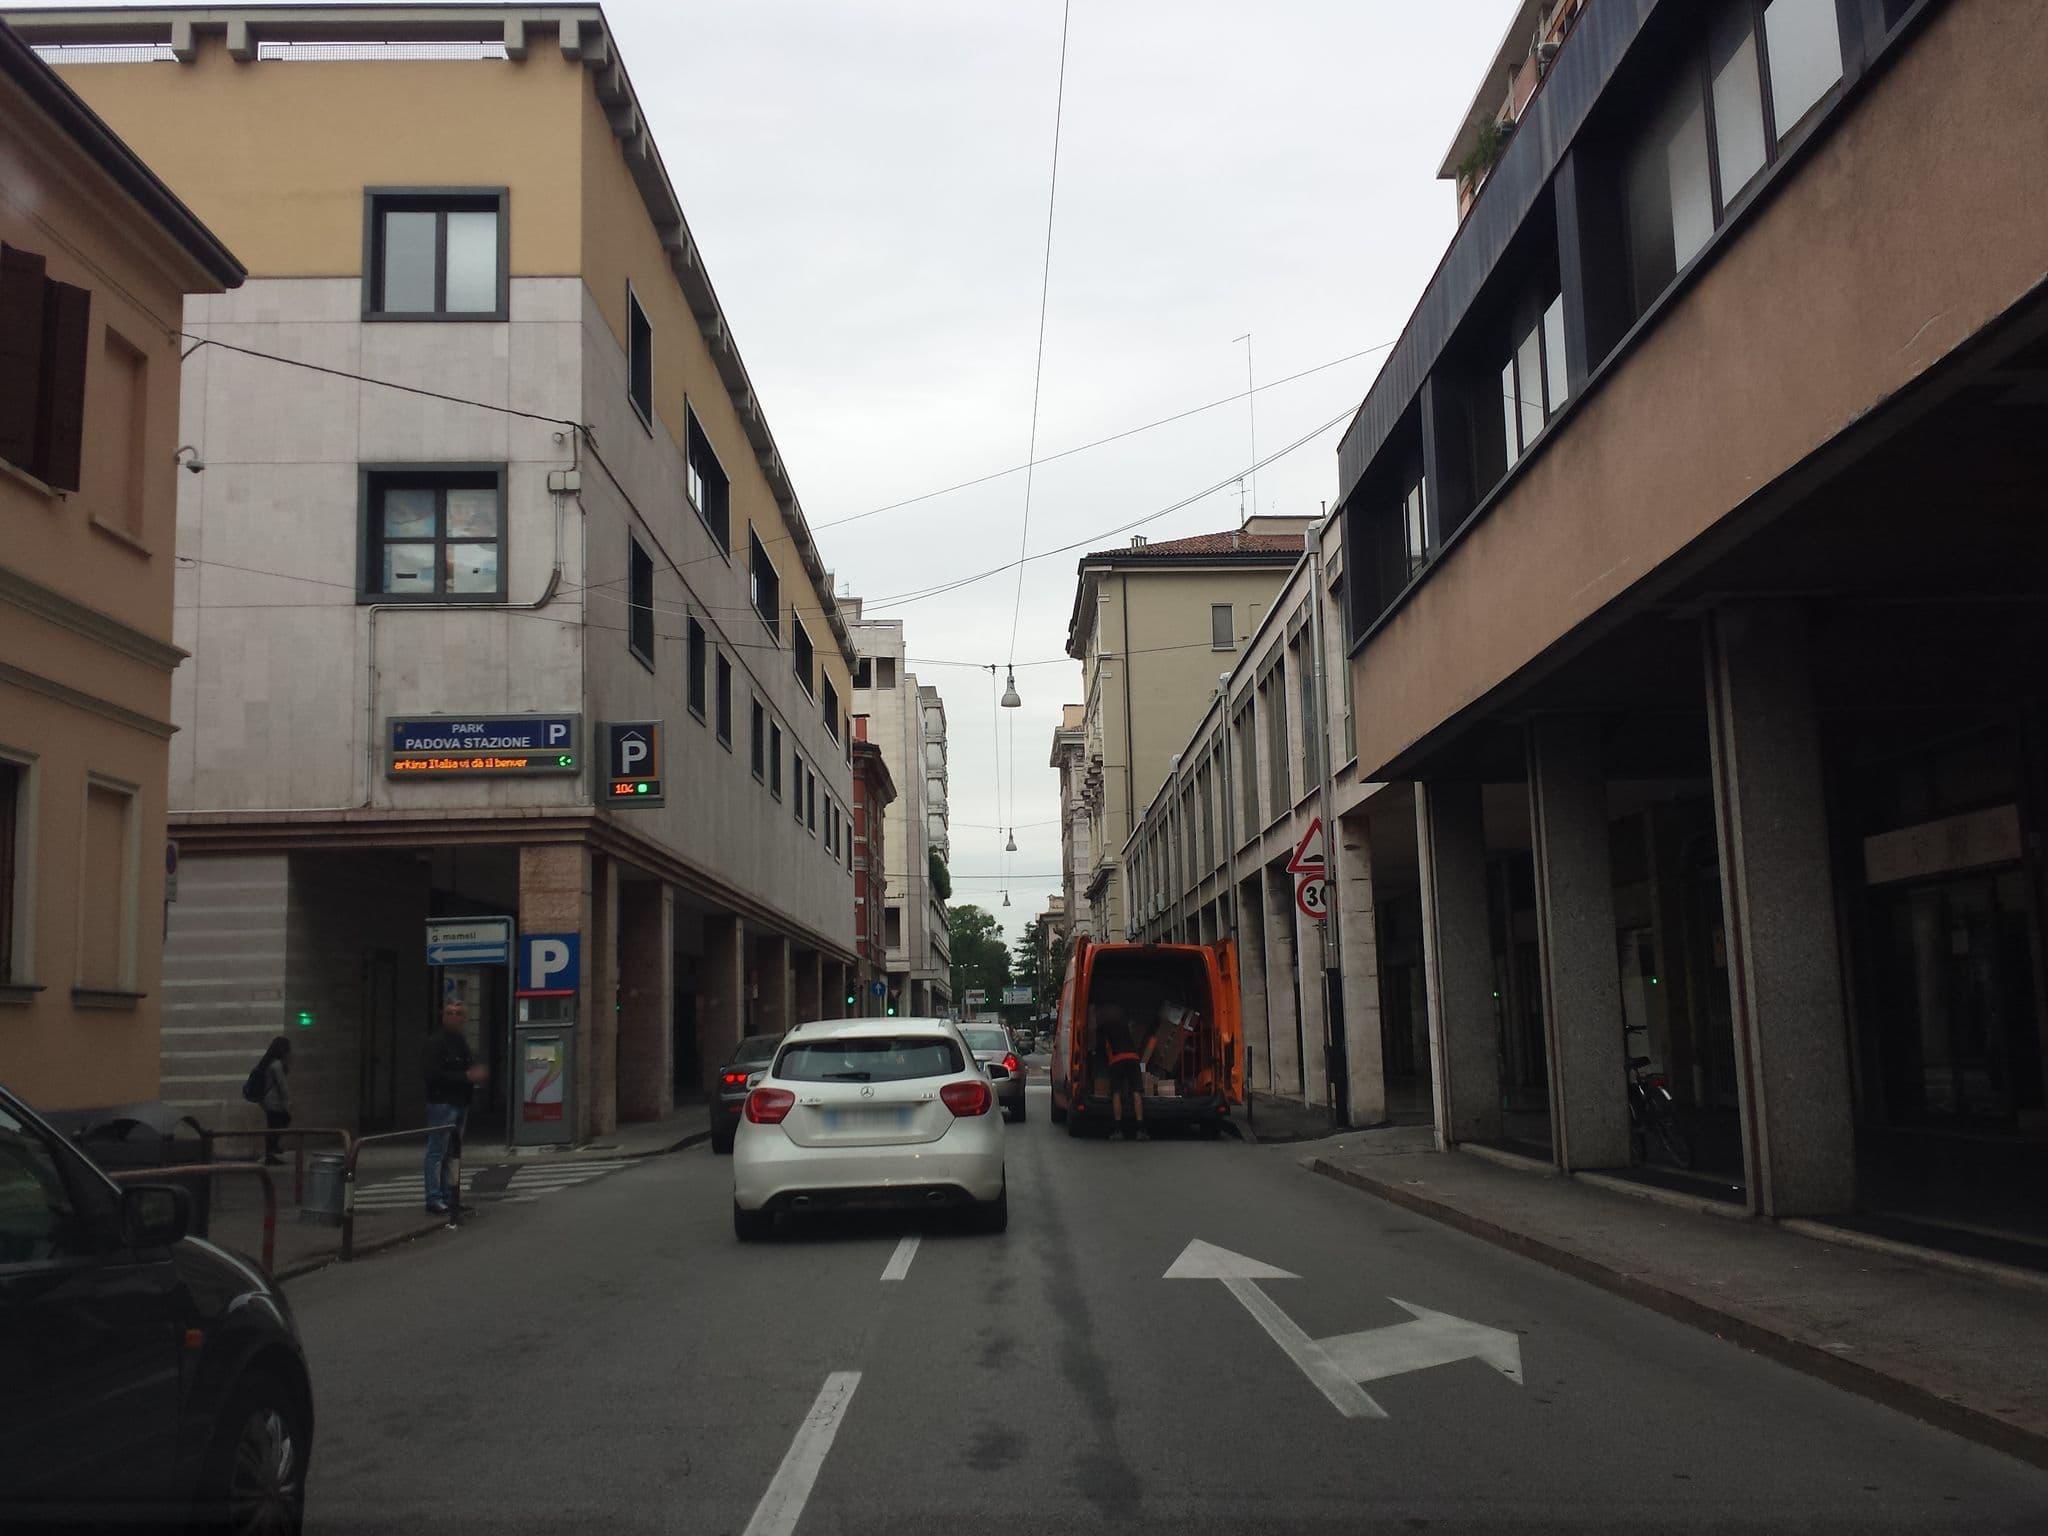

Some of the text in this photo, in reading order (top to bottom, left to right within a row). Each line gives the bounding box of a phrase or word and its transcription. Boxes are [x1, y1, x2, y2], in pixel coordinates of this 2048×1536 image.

[452, 724, 485, 734] PARK
[549, 724, 567, 745] P
[405, 736, 531, 750] PADOVA STAZIONE
[622, 740, 648, 774] P
[531, 939, 570, 989] P
